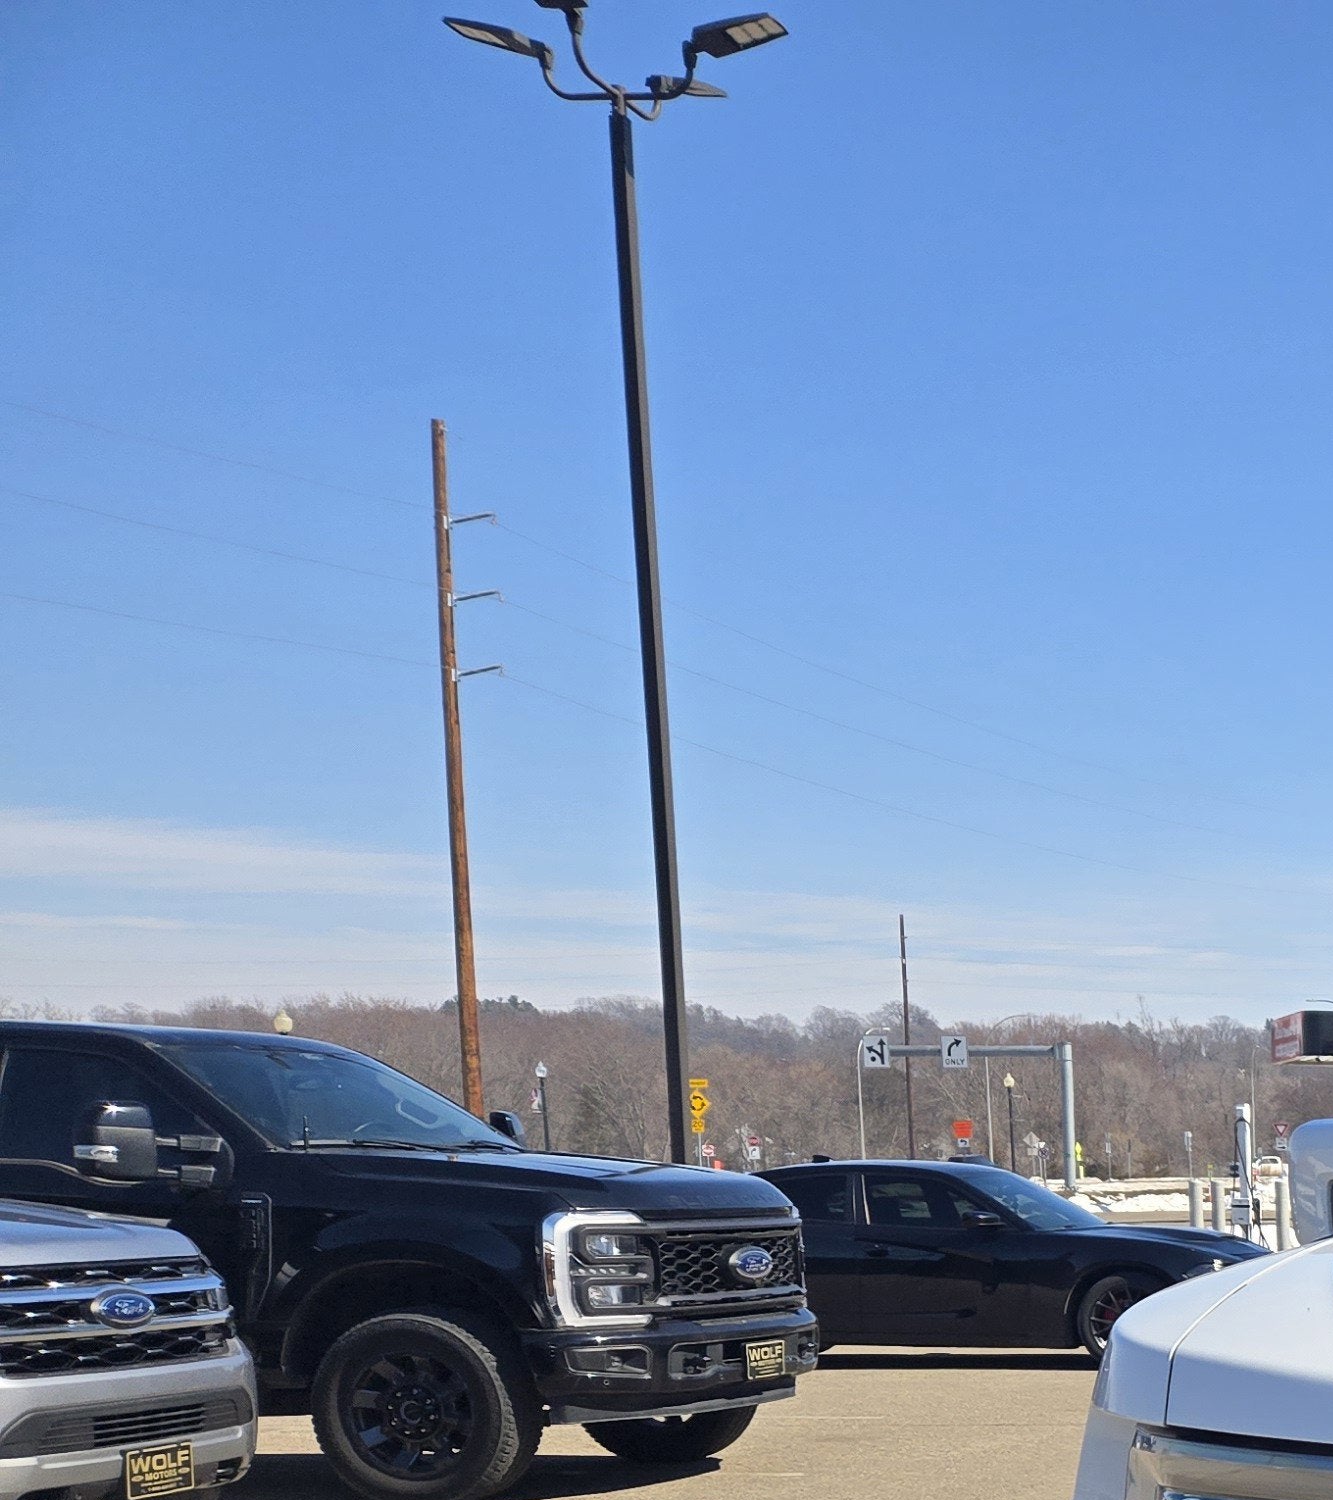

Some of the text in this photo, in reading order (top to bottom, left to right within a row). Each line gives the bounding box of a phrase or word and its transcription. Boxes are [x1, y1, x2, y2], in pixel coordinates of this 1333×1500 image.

[945, 1058, 965, 1067] ONLY
[748, 1345, 783, 1361] WOLF
[130, 1449, 190, 1475] WOLF
[144, 1468, 178, 1481] MOTORS
